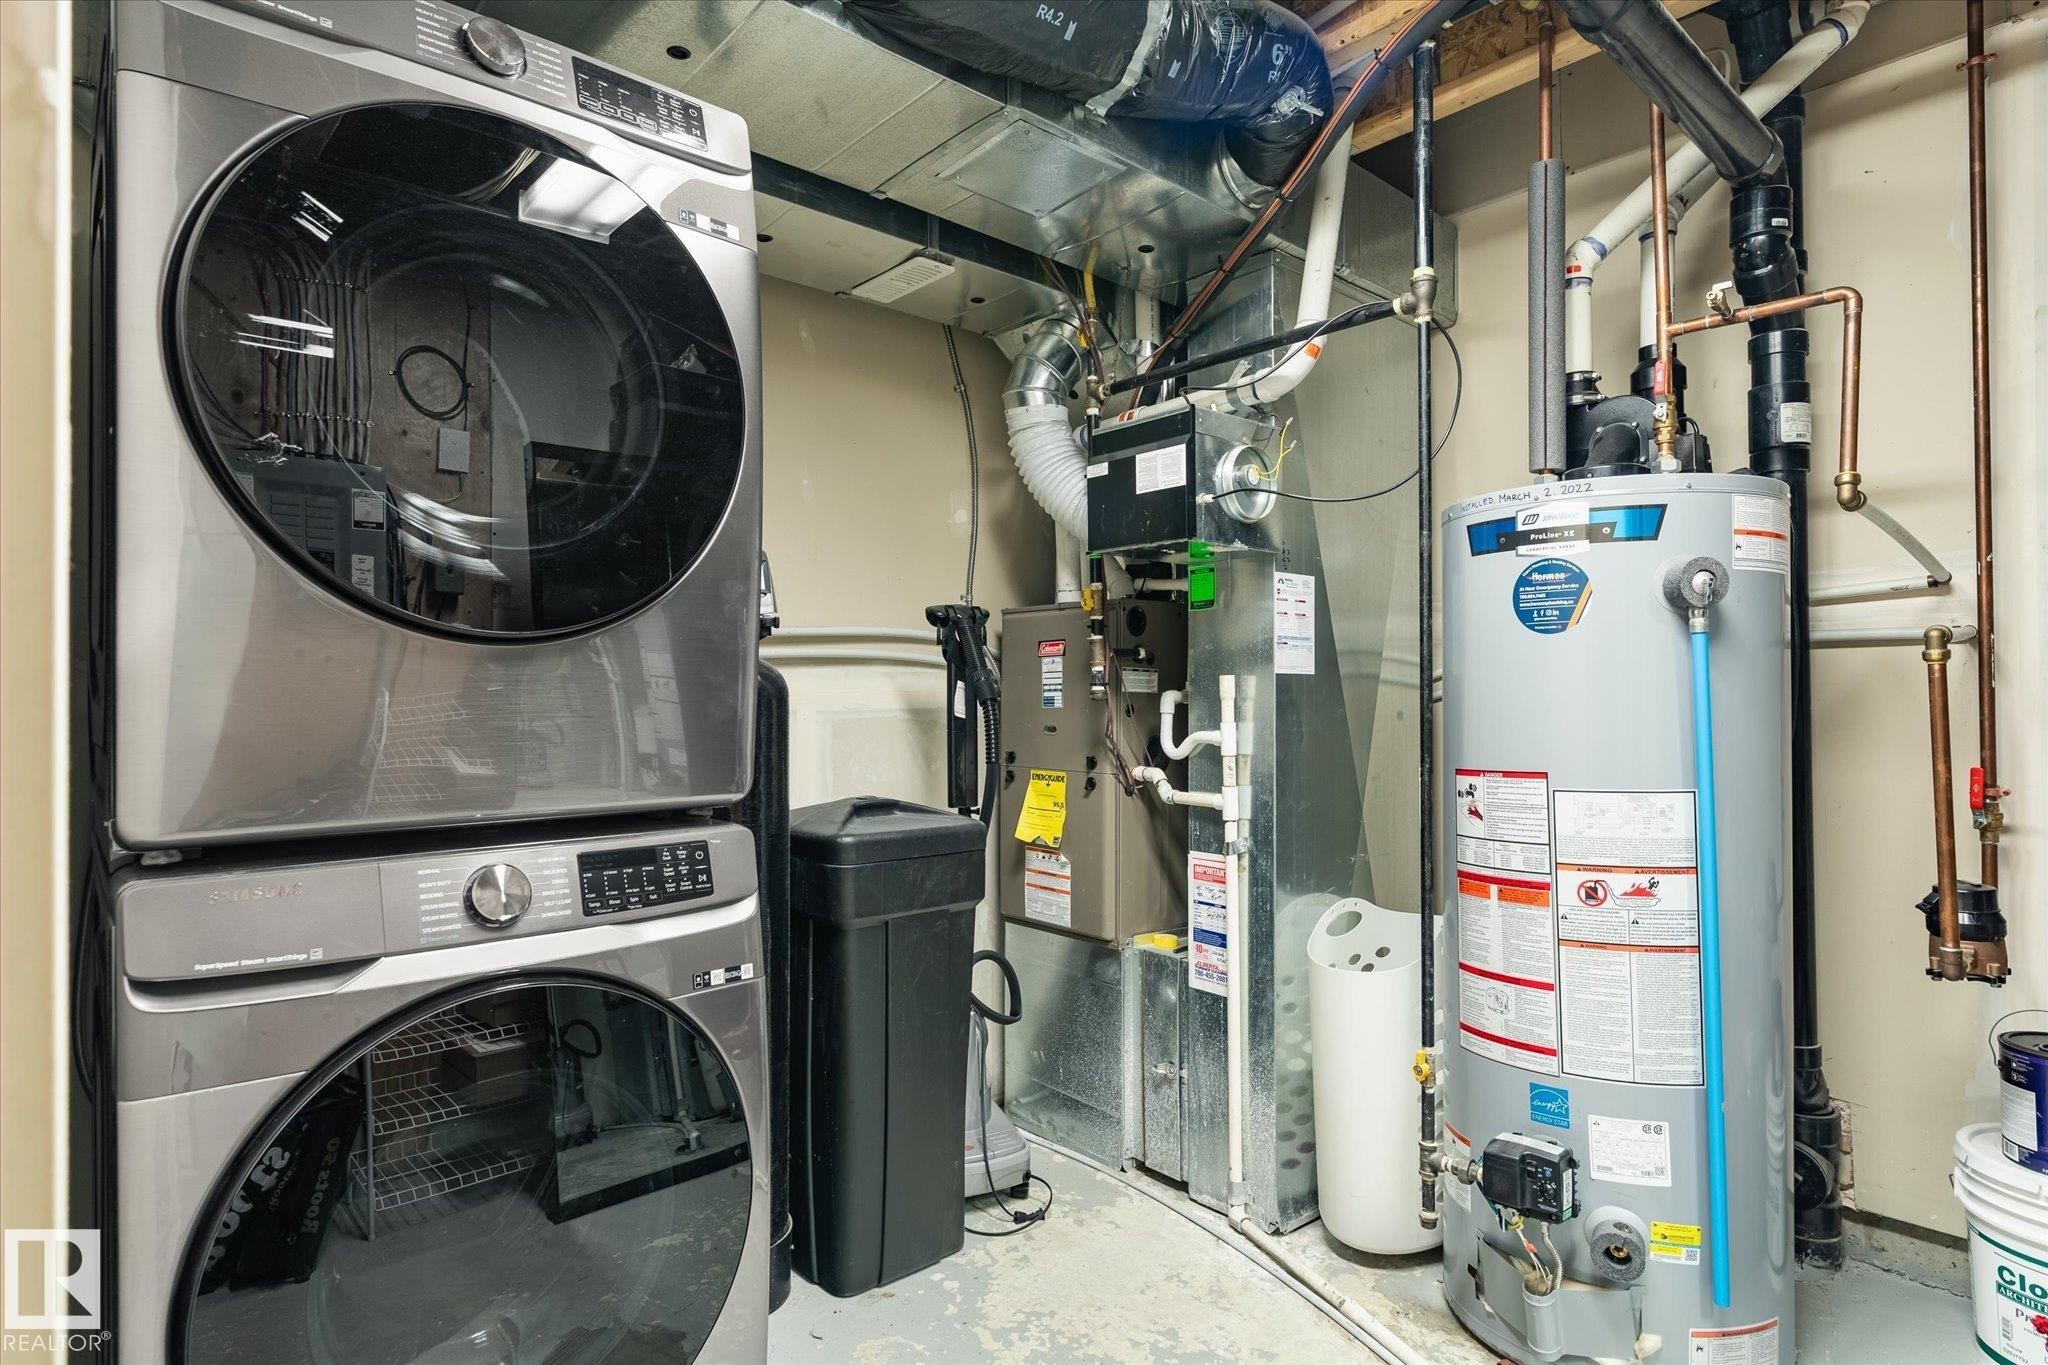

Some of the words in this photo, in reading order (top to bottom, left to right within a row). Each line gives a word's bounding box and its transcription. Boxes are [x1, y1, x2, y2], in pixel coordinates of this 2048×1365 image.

[415, 7, 433, 17] HEAVY
[433, 13, 448, 22] DUTY
[1035, 3, 1065, 27] R4.2
[418, 34, 436, 43] STEAM
[432, 30, 450, 40] PRESS
[418, 43, 443, 55] REFRESH
[543, 69, 555, 78] TIME
[1498, 490, 1532, 504] MARCH
[1559, 482, 1594, 496] 2022
[1542, 511, 1559, 523] John
[1563, 529, 1576, 538] XE
[422, 926, 440, 934] STEAM
[240, 958, 265, 966] Steam
[265, 953, 308, 963] SmartThings
[1532, 1113, 1554, 1123] ENERGY
[1553, 1118, 1569, 1127] STAR
